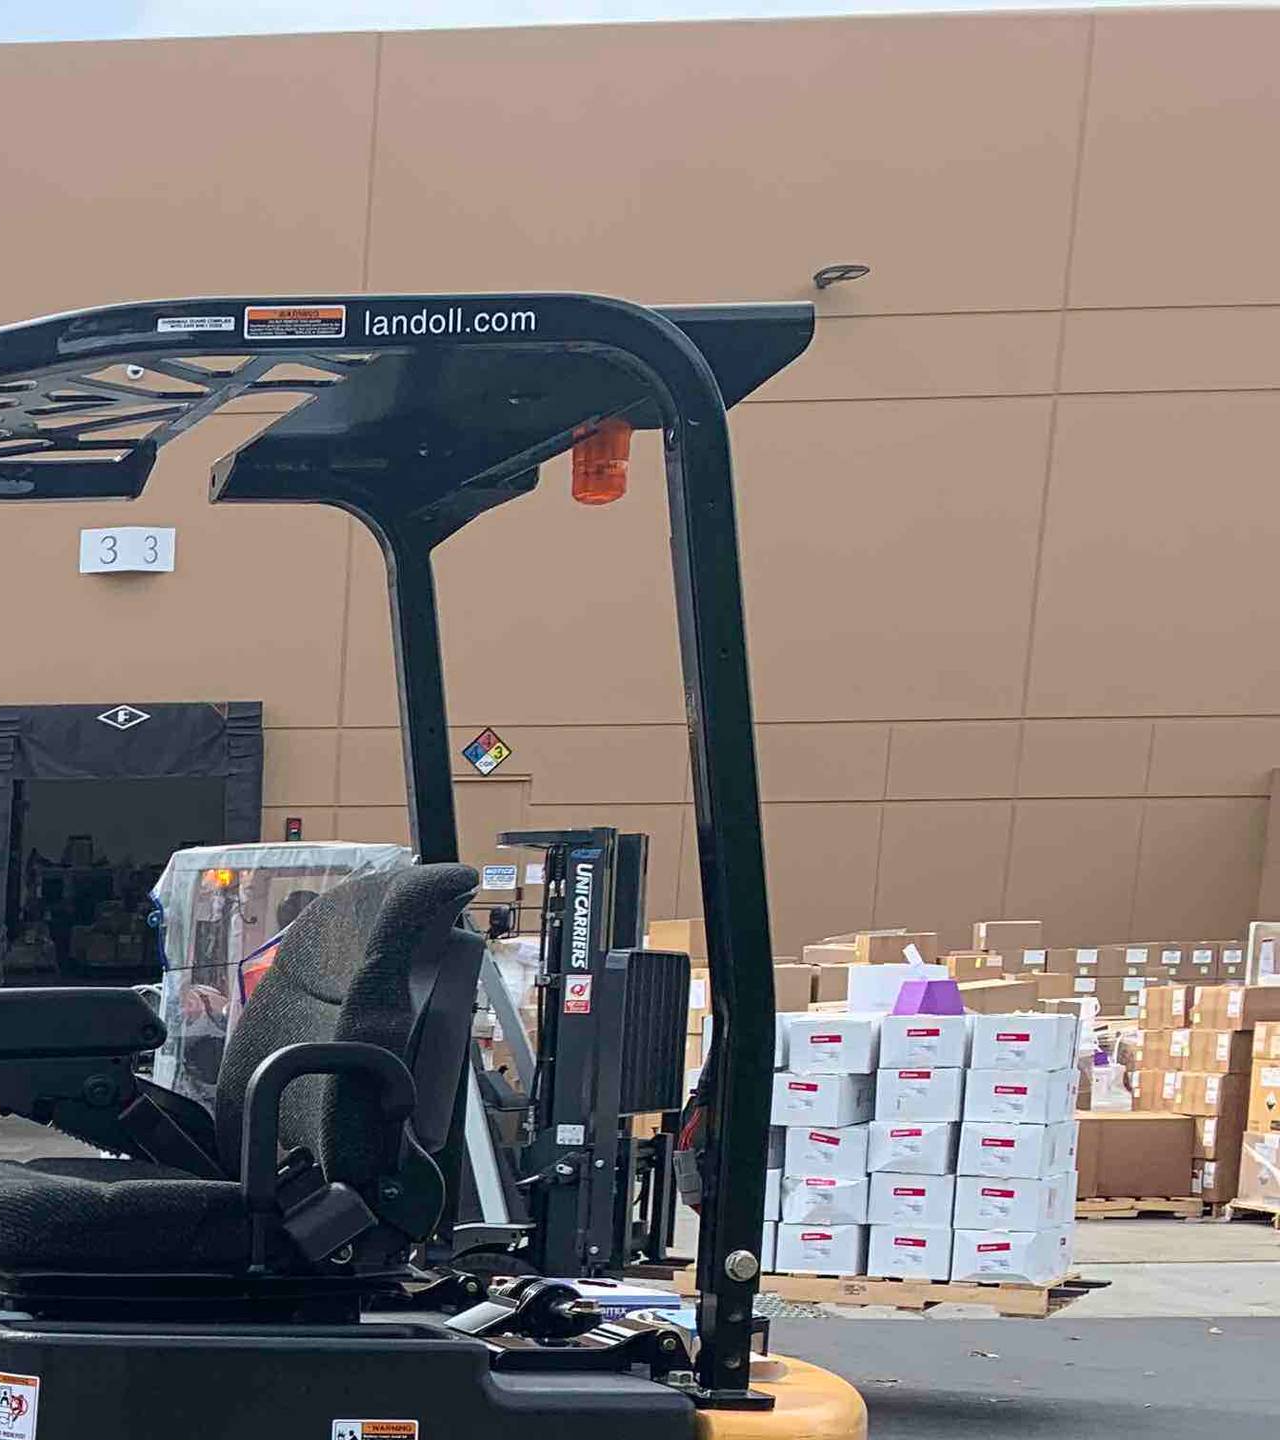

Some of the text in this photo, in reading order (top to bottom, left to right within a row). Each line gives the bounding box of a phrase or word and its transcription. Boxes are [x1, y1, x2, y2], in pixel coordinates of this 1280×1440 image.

[365, 307, 536, 336] landoll.com
[100, 535, 159, 565] 3 3
[493, 745, 504, 760] 3
[571, 863, 593, 969] UNICARRIERS
